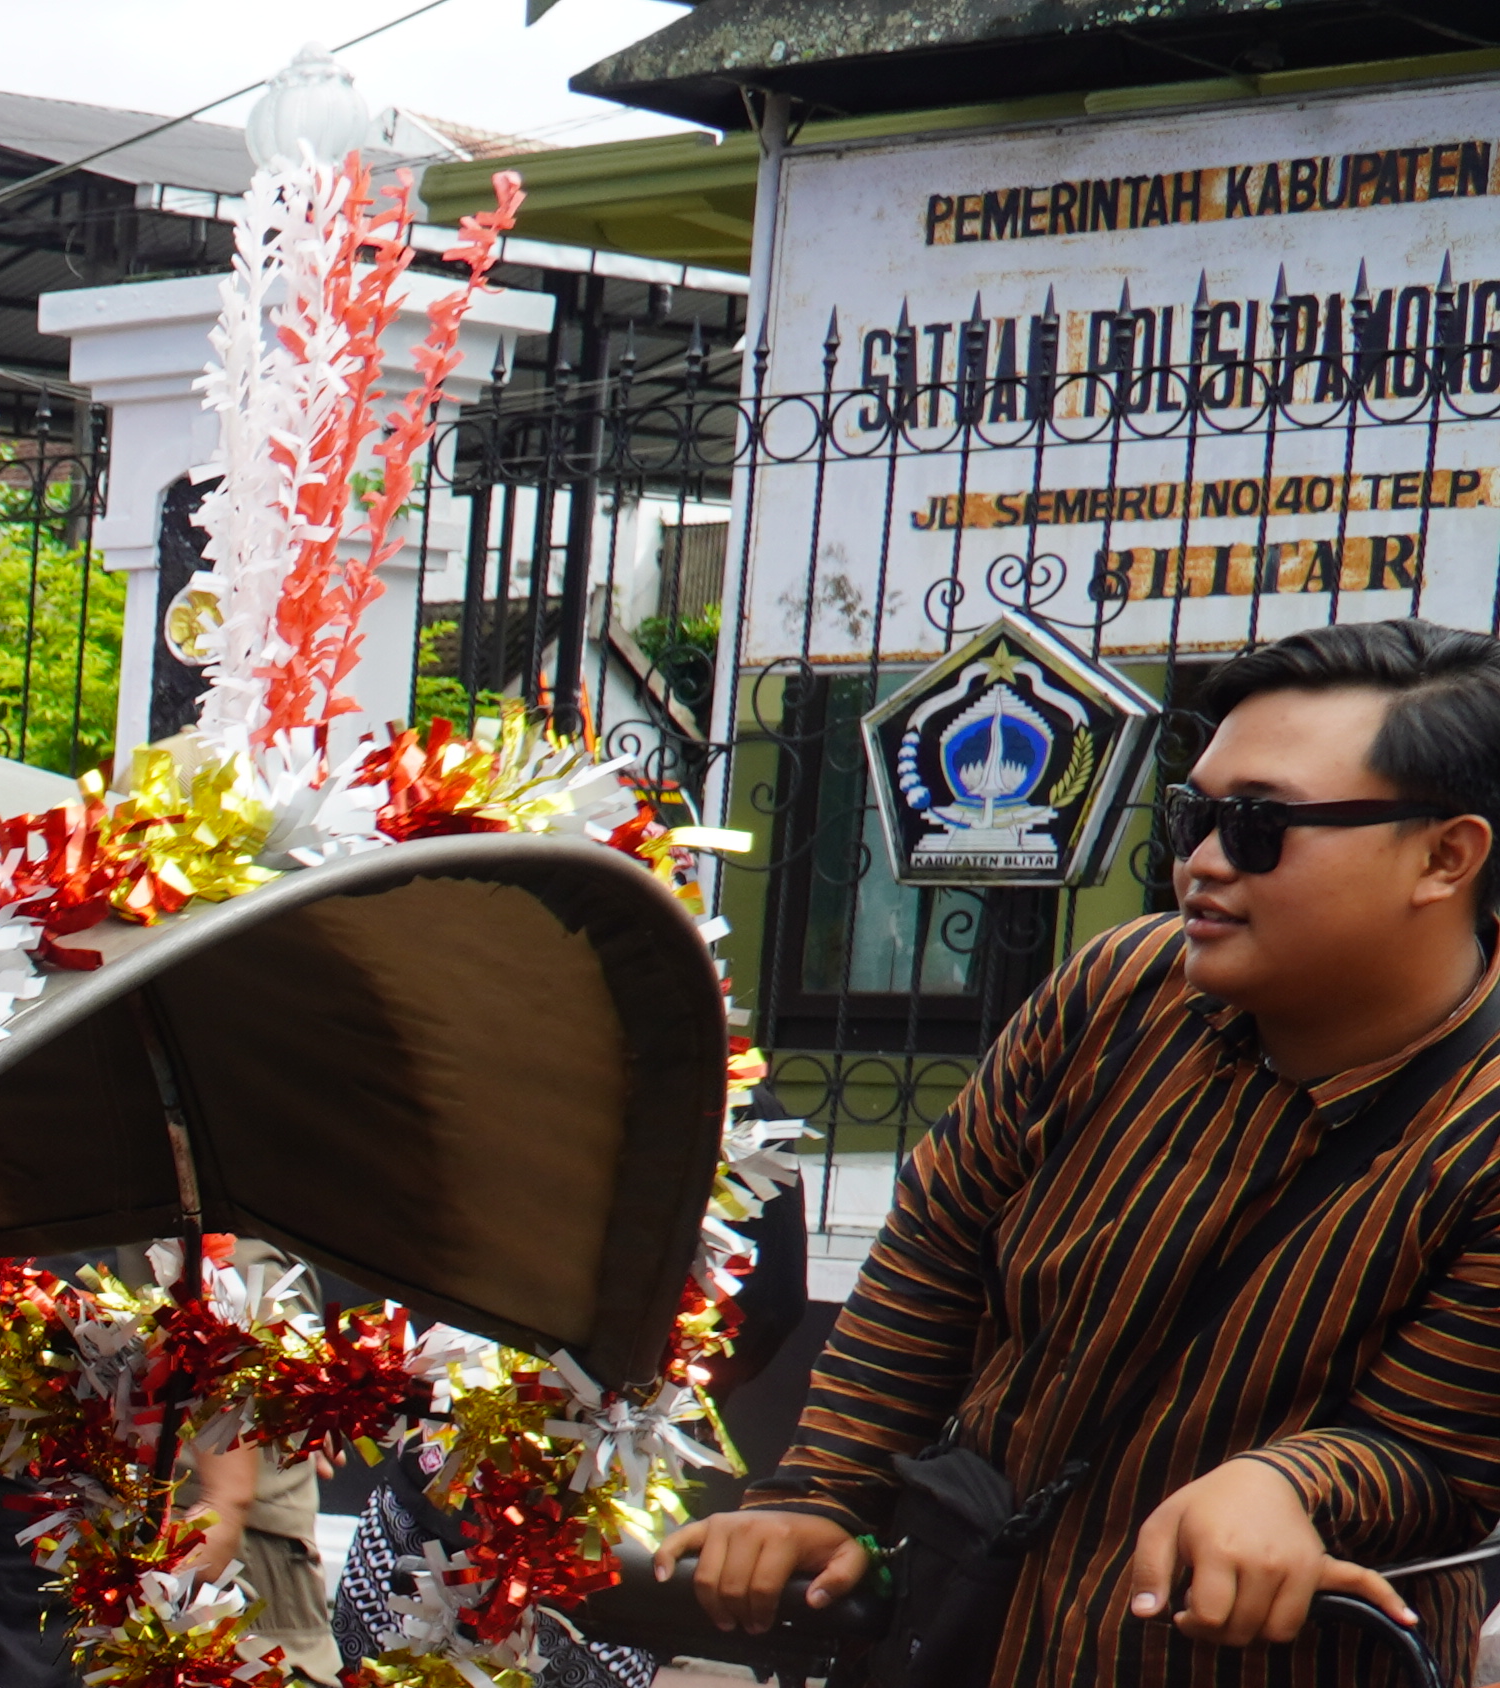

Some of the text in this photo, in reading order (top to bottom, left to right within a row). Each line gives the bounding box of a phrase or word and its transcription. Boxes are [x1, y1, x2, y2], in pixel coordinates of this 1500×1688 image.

[925, 140, 1492, 247] PEMERINTAH KABUPATEN
[993, 483, 1179, 527] SEMERU
[1274, 474, 1336, 515] 40
[1087, 534, 1424, 602] BLITAR
[913, 853, 1054, 868] KABUPATEN BLITAR
